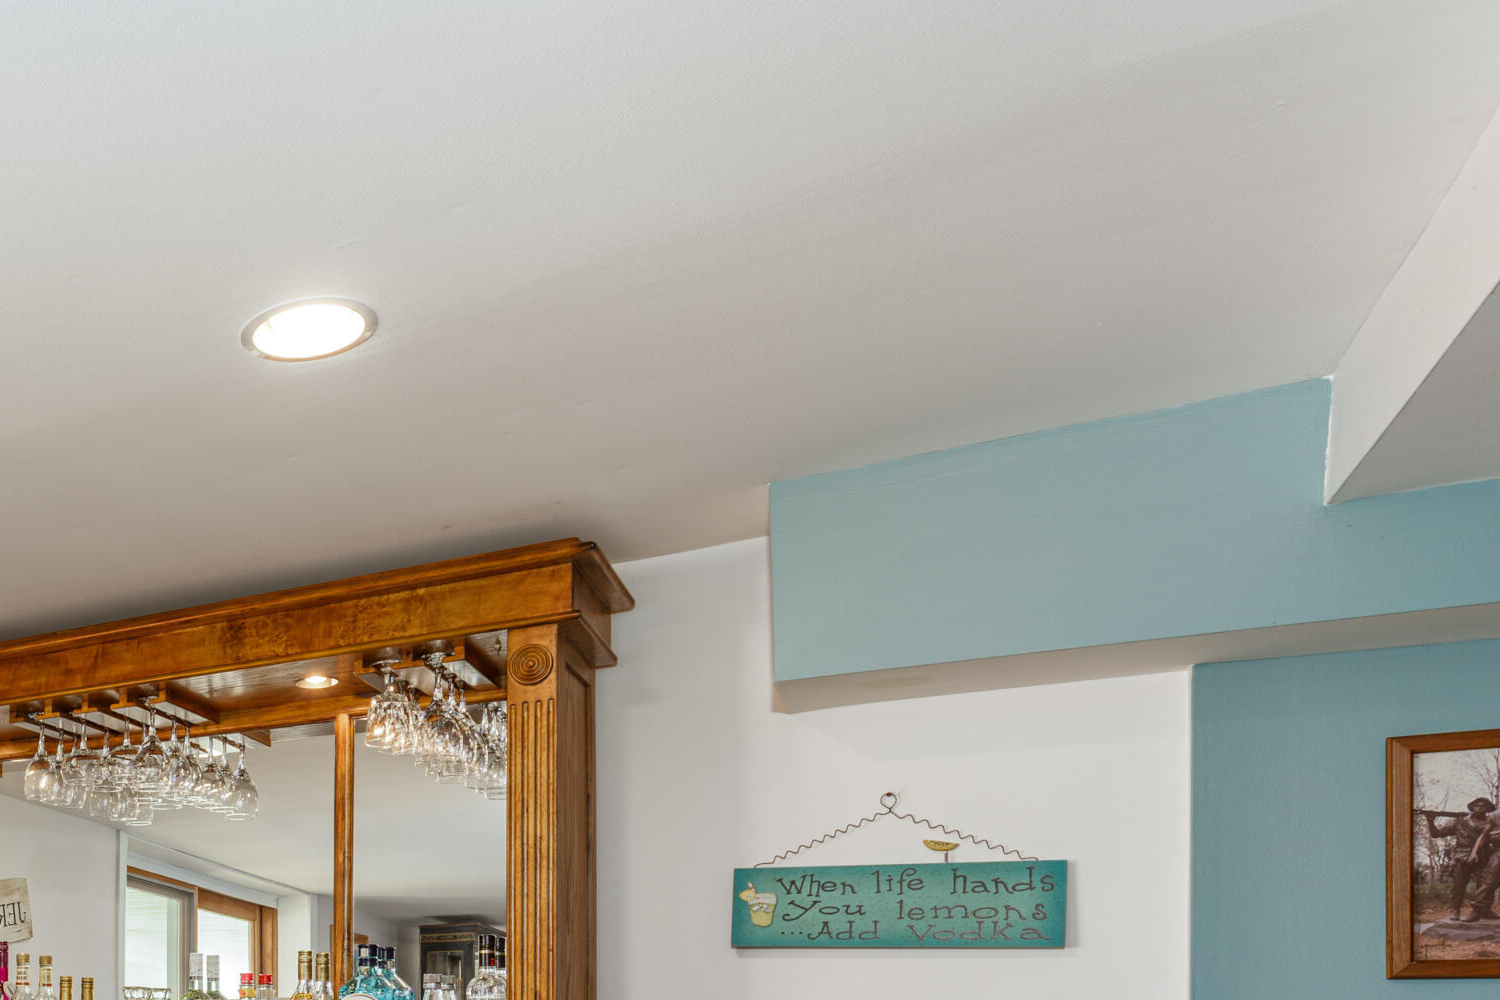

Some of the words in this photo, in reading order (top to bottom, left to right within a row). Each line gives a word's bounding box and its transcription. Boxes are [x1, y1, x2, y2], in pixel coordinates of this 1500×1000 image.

[776, 873, 857, 897] When
[871, 867, 925, 896] life
[950, 866, 1055, 895] hands
[896, 899, 1048, 921] lemons
